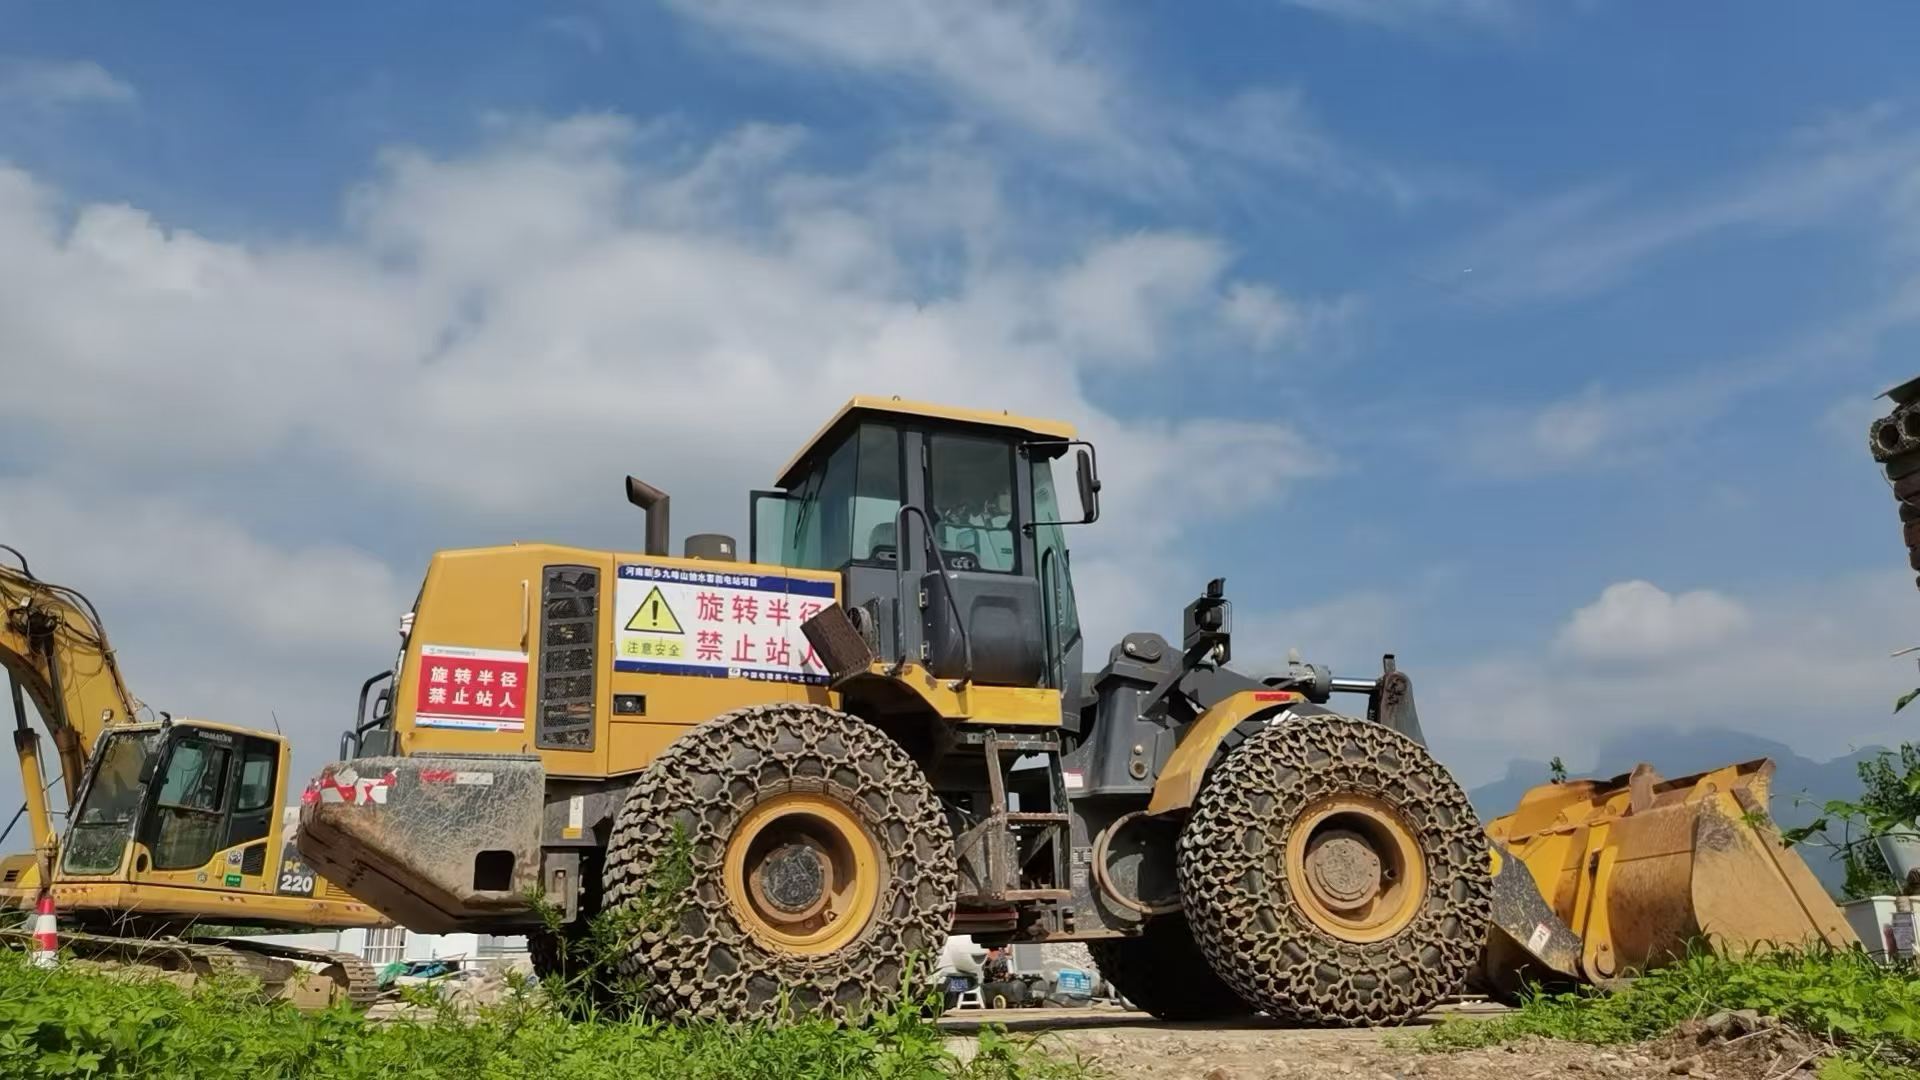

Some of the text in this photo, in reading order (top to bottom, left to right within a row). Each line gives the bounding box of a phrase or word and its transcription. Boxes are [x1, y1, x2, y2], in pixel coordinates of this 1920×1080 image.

[627, 641, 681, 657] 注意安全
[696, 630, 824, 670] 禁止站人
[430, 665, 518, 688] 旋转半径
[428, 686, 516, 709] 禁止站人
[280, 874, 313, 893] 220
